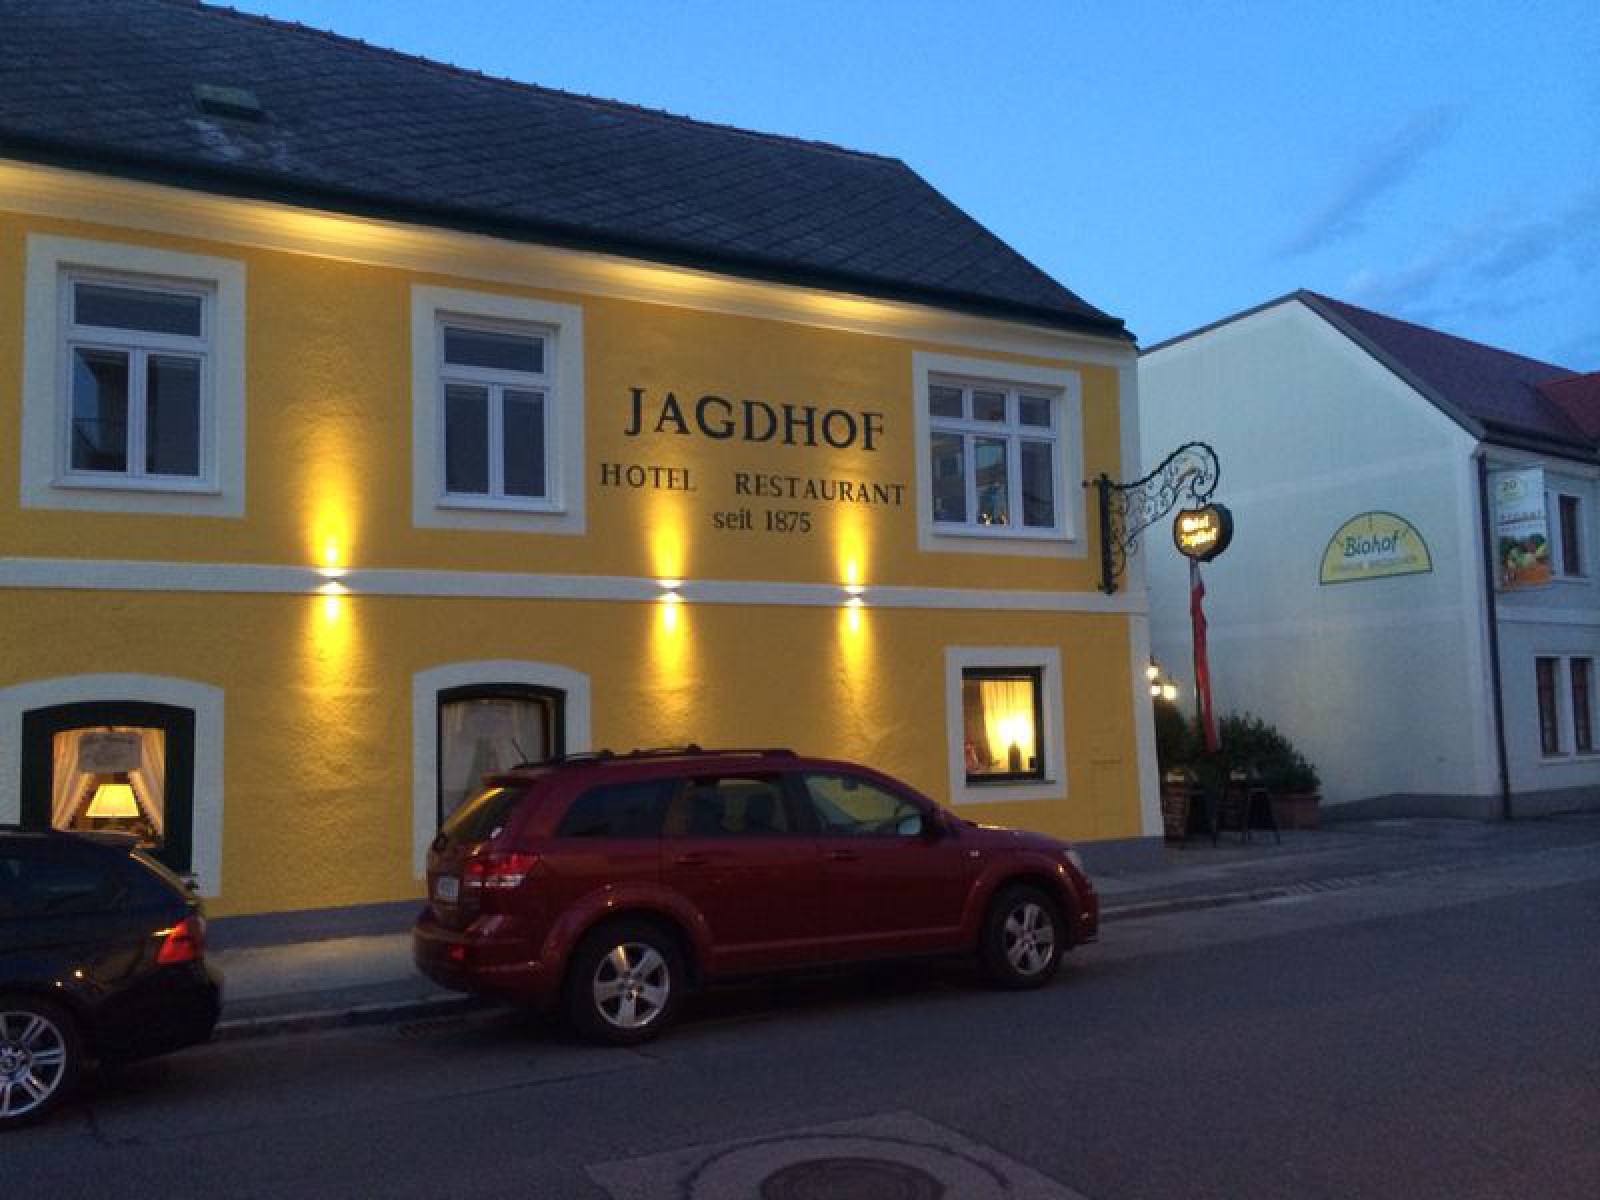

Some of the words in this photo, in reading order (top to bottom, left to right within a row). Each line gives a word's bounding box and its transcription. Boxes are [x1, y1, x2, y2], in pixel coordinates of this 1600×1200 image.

[624, 387, 884, 450] JAGDHOF
[601, 463, 697, 490] HOTEL
[735, 472, 905, 505] RESTAURANT
[713, 510, 753, 530] seit
[766, 511, 812, 533] 1875
[1344, 530, 1398, 557] Biohof
